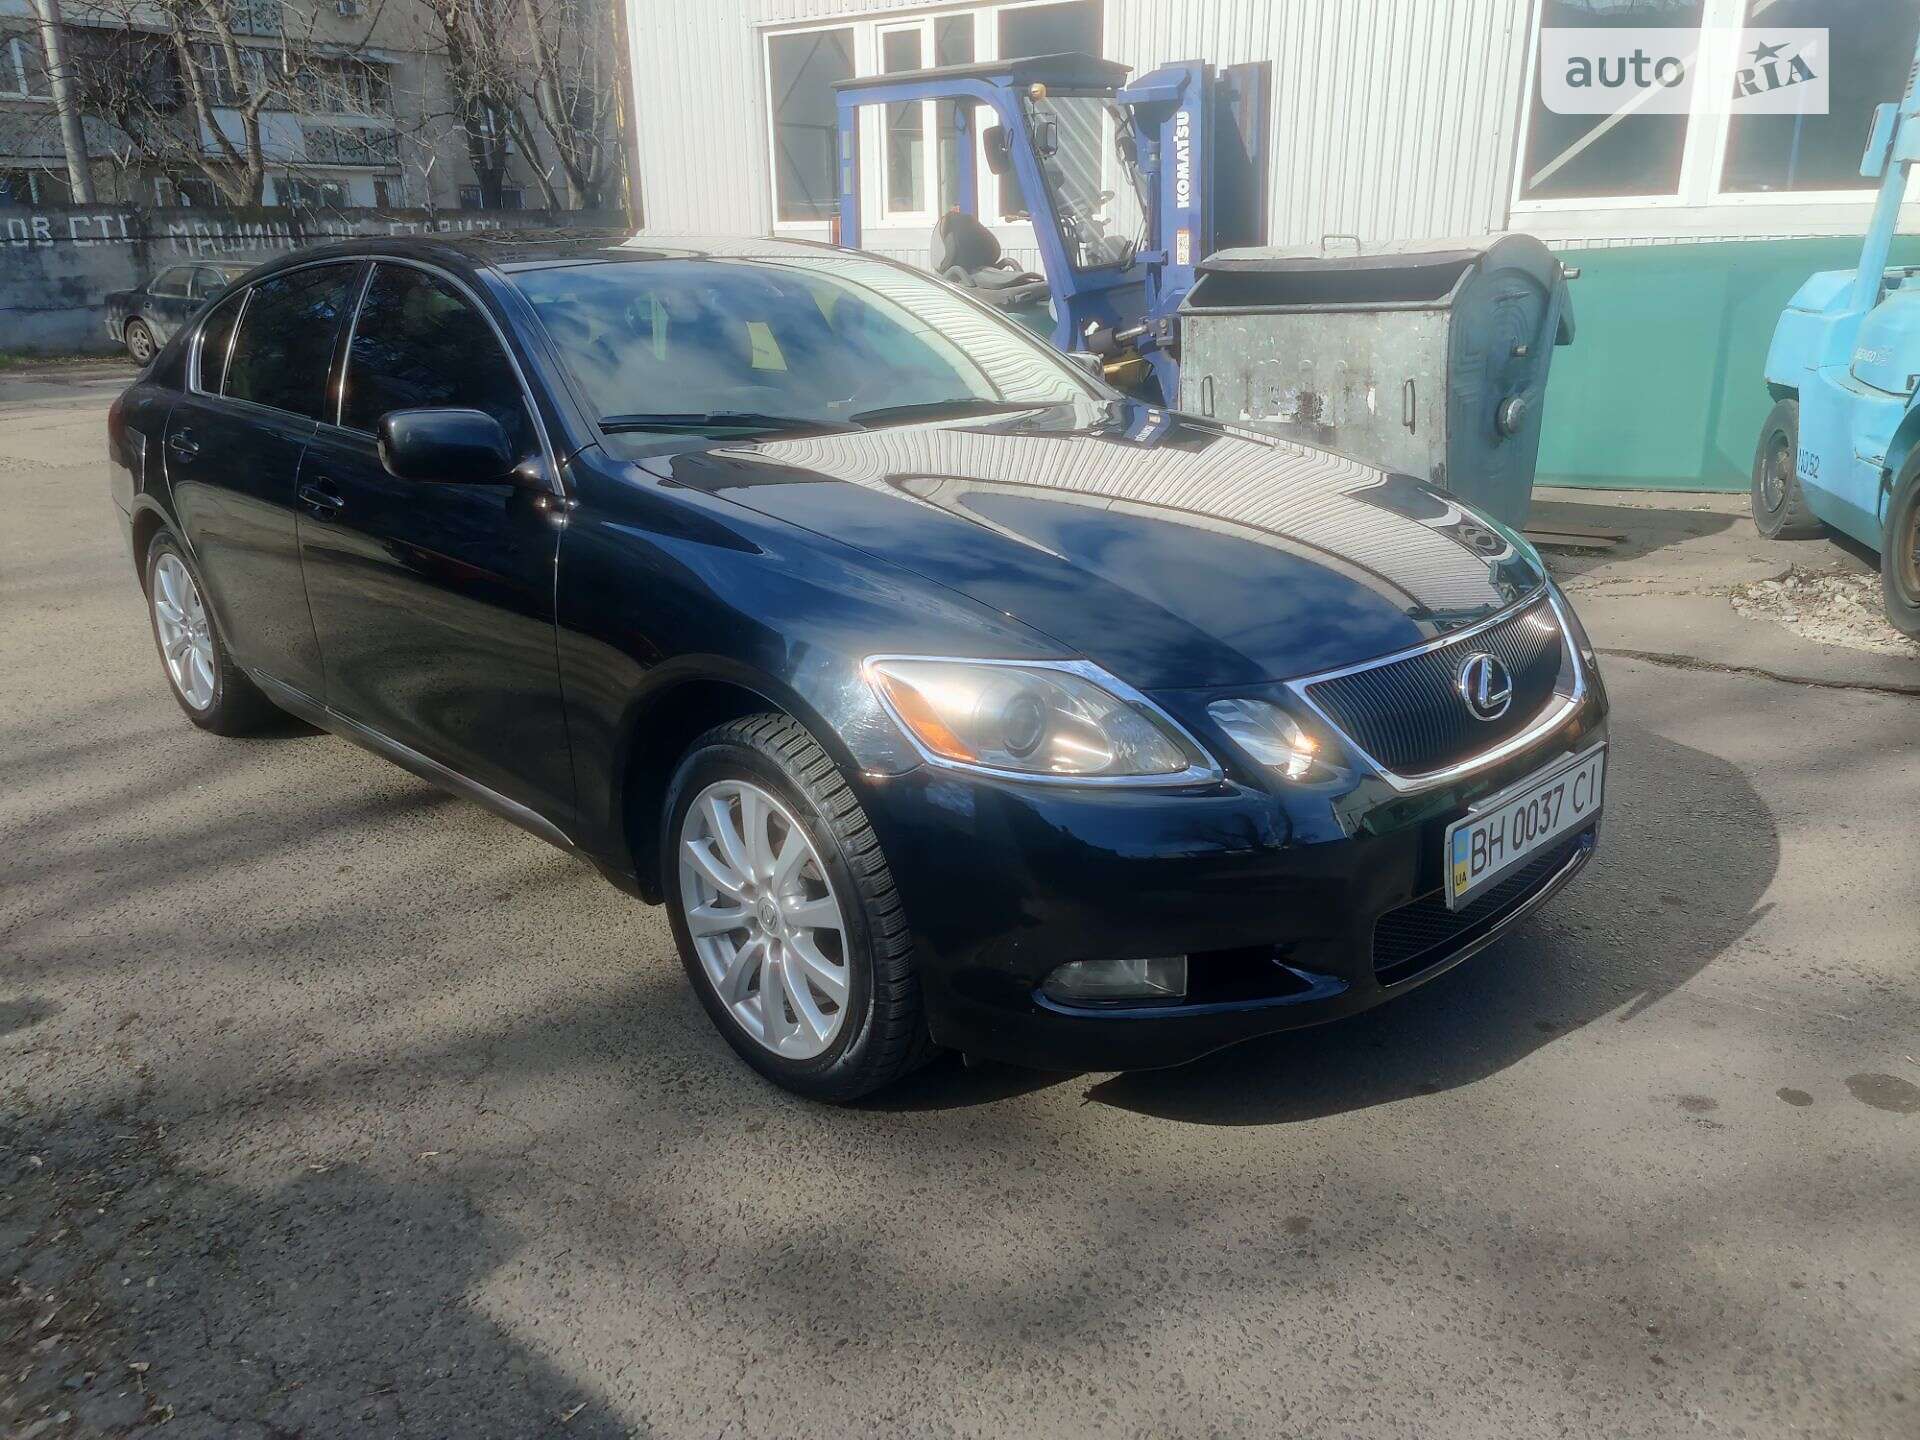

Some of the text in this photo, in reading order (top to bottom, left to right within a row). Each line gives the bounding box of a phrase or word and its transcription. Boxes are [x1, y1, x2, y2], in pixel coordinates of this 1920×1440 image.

[1173, 111, 1190, 209] KOMATSU
[1472, 764, 1595, 877] BH 0037 CI
[1455, 871, 1467, 886] UA
